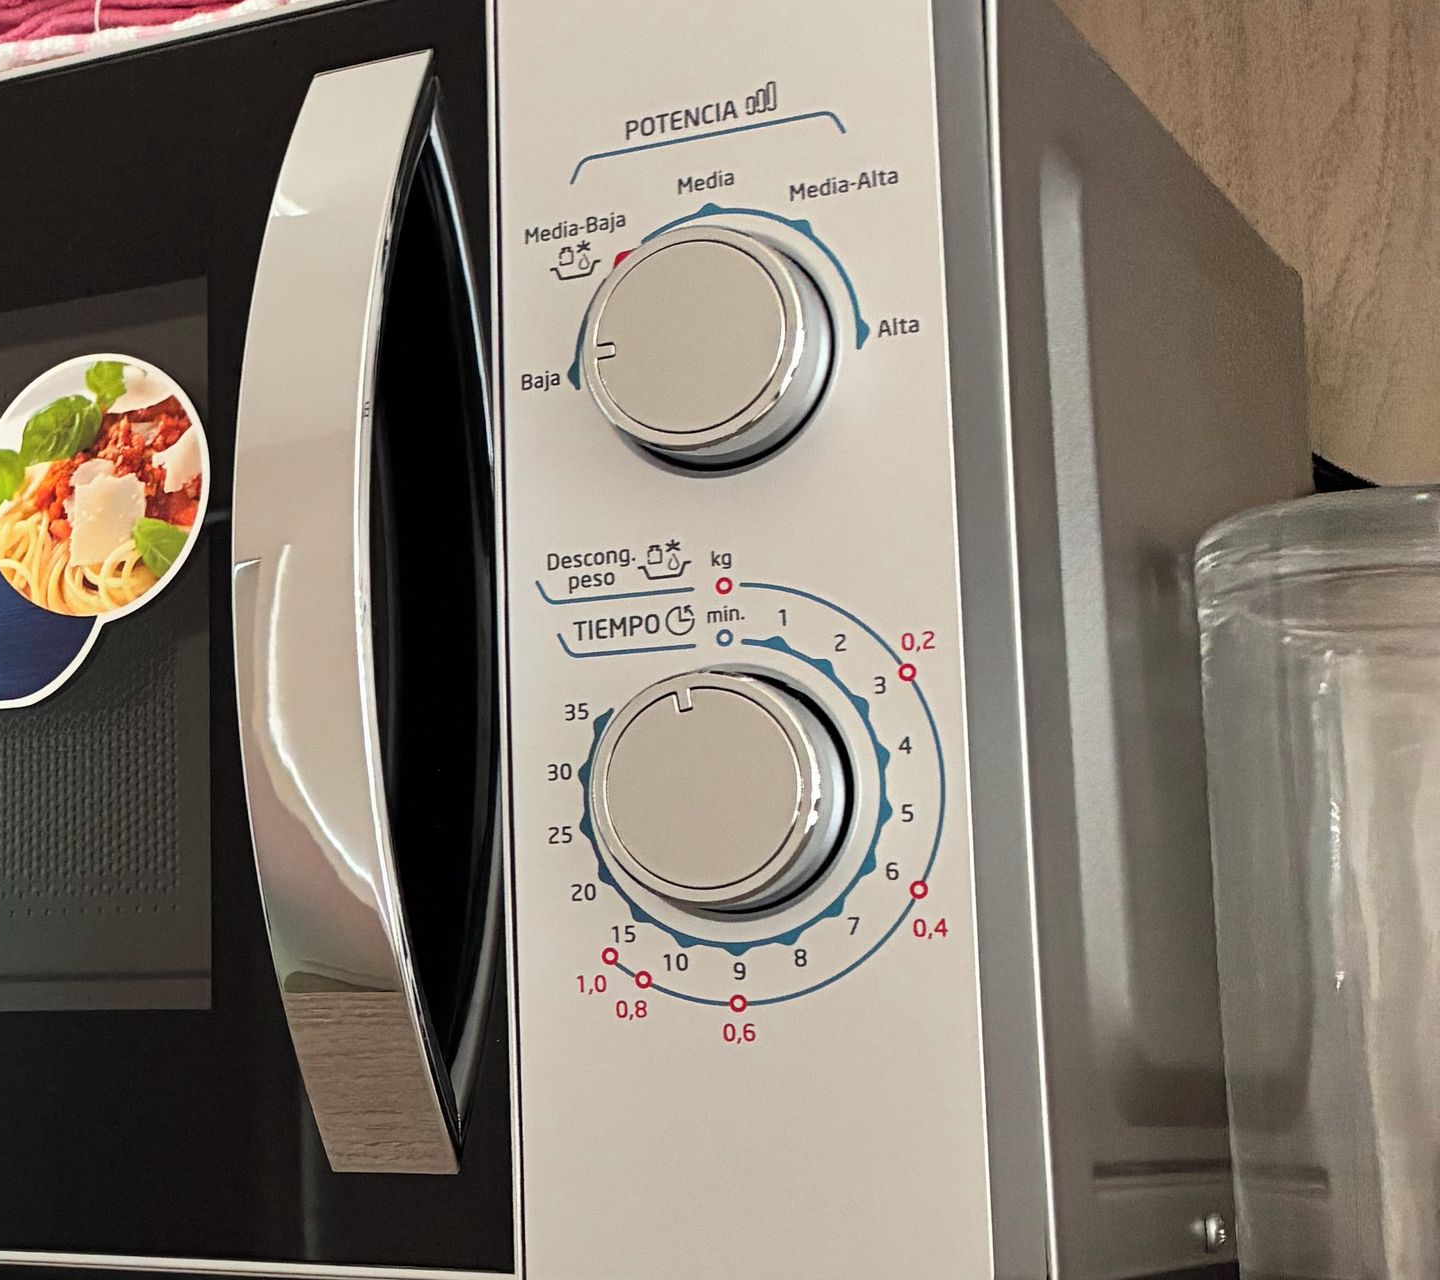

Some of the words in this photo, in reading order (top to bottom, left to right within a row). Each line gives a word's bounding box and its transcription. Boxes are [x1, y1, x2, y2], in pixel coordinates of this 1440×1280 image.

[625, 100, 738, 140] POTENCIA
[678, 170, 735, 195] Media
[789, 169, 899, 202] Media-Alta
[524, 213, 626, 245] Media-Baja
[878, 318, 920, 337] Alta
[521, 372, 560, 391] Baja
[547, 549, 636, 571] Descong.
[710, 551, 732, 569] kg
[568, 570, 615, 593] peso
[573, 613, 660, 641] TIEMPO
[707, 606, 745, 623] min.
[779, 610, 787, 626] 1
[834, 634, 847, 652] 2
[901, 631, 935, 653] 0,2
[874, 677, 886, 694] 3
[565, 703, 589, 721] 35
[899, 737, 912, 754] 4
[547, 764, 572, 781] 30
[902, 805, 914, 822] 5
[548, 826, 572, 844] 25
[886, 863, 899, 880] 6
[571, 884, 596, 902] 20
[612, 926, 636, 943] 15
[848, 917, 860, 935] 7
[912, 918, 948, 939] 0,4
[664, 953, 688, 971] 10
[795, 949, 807, 967] 8
[733, 962, 746, 980] 9
[576, 974, 607, 993] 1,0
[615, 1000, 648, 1020] 0,8
[722, 1023, 756, 1044] 0,6
